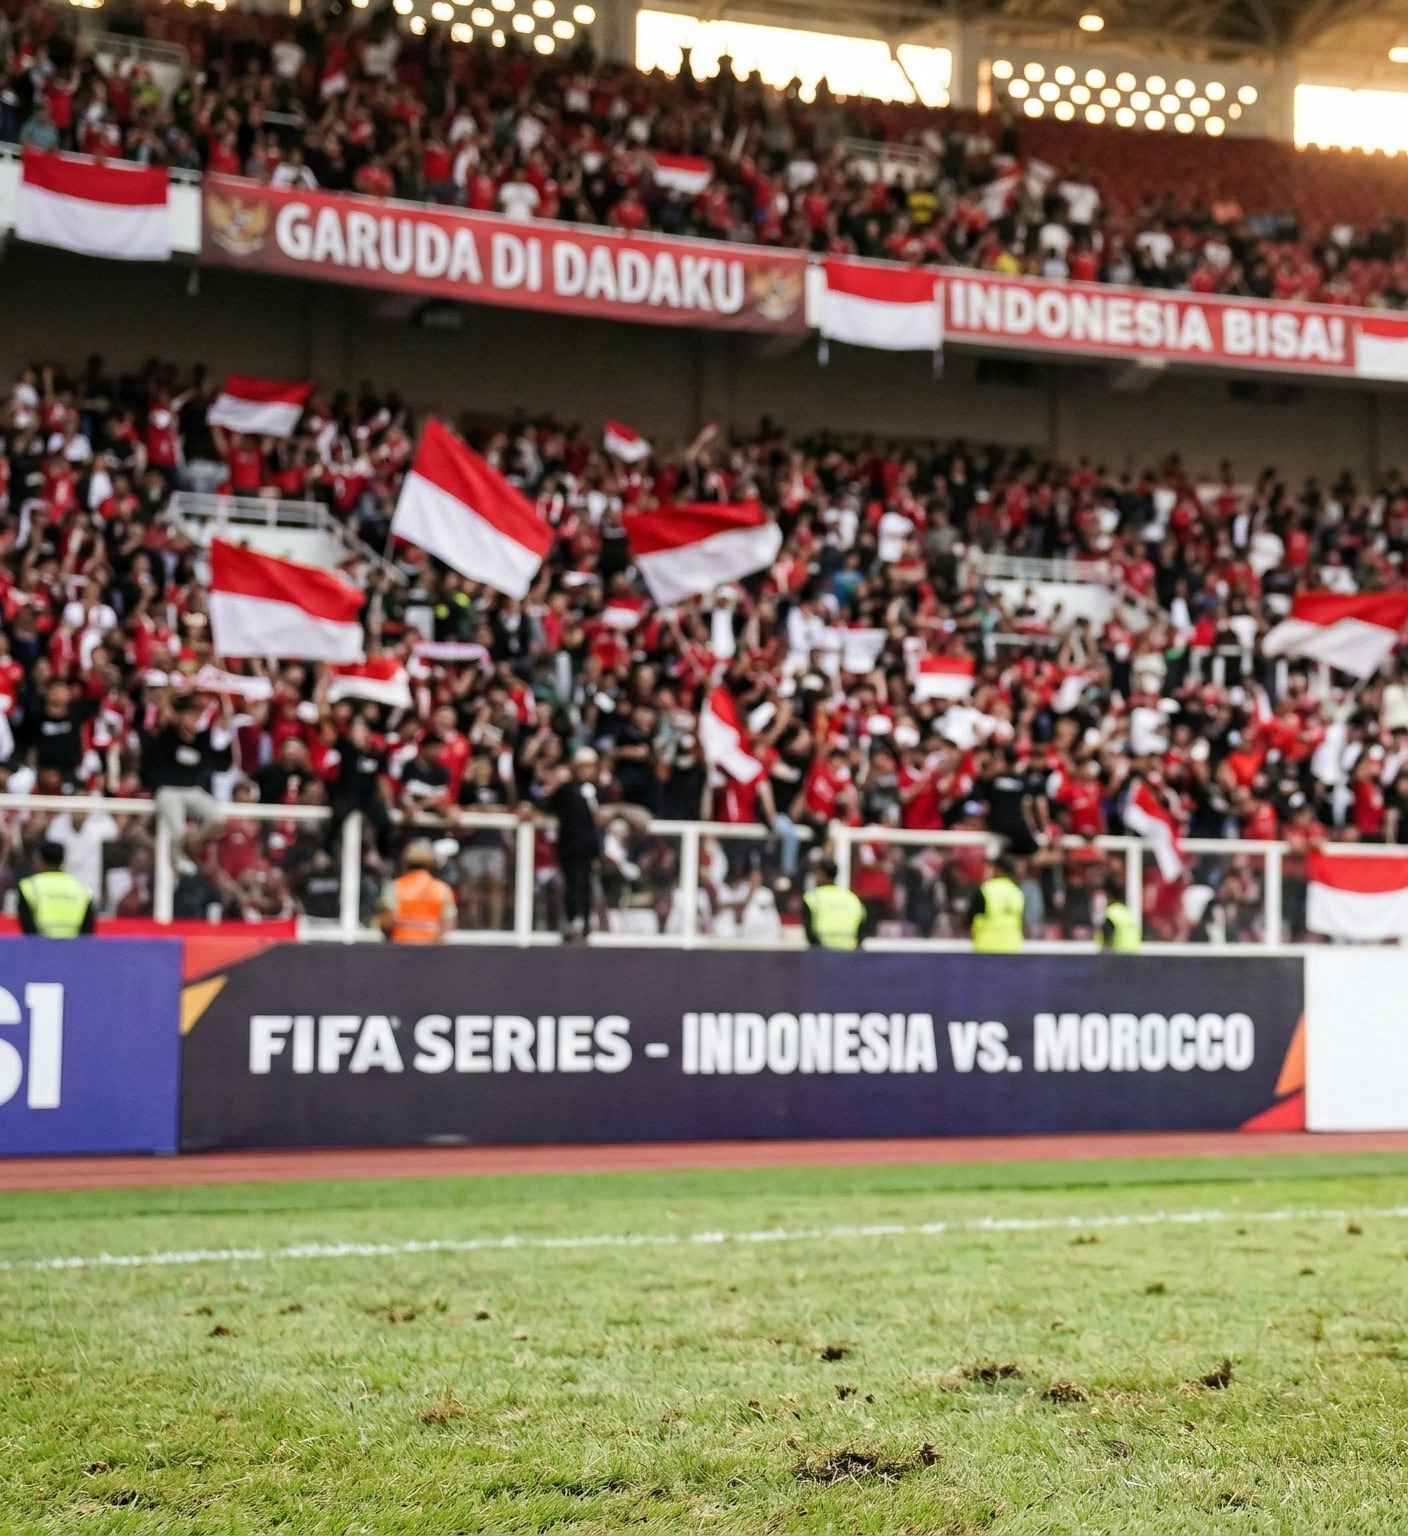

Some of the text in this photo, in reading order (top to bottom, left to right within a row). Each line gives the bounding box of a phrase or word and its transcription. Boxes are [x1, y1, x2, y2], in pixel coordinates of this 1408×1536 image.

[275, 202, 747, 316] GARUDA DI DADAKU
[949, 279, 1346, 362] INDONESIA BISA!
[249, 1014, 402, 1075] FIFA
[413, 1014, 633, 1075] SERIES
[681, 1012, 937, 1075] INDONESIA
[1034, 1012, 1254, 1073] MOROCCO
